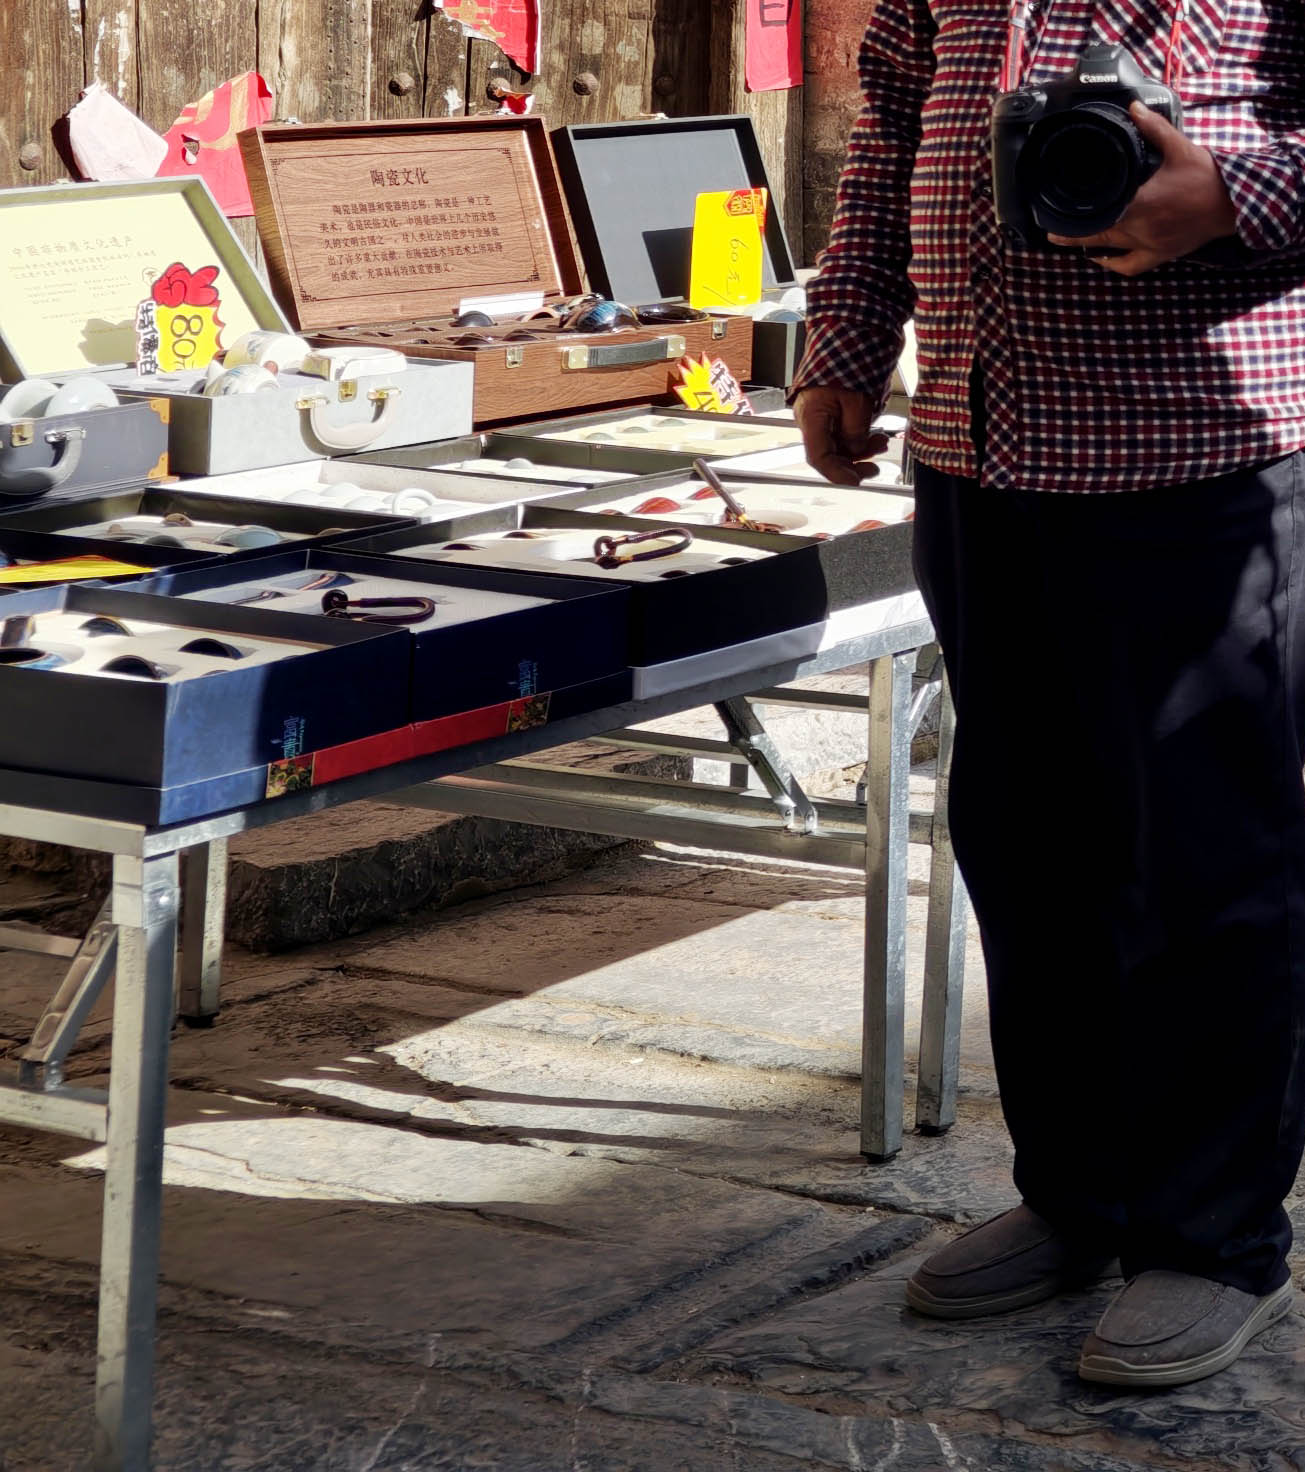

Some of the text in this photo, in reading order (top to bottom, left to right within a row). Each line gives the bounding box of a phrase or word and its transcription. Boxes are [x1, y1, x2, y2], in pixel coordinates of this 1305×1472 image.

[1079, 72, 1119, 84] Canon
[369, 166, 430, 188] 陶瓷文化
